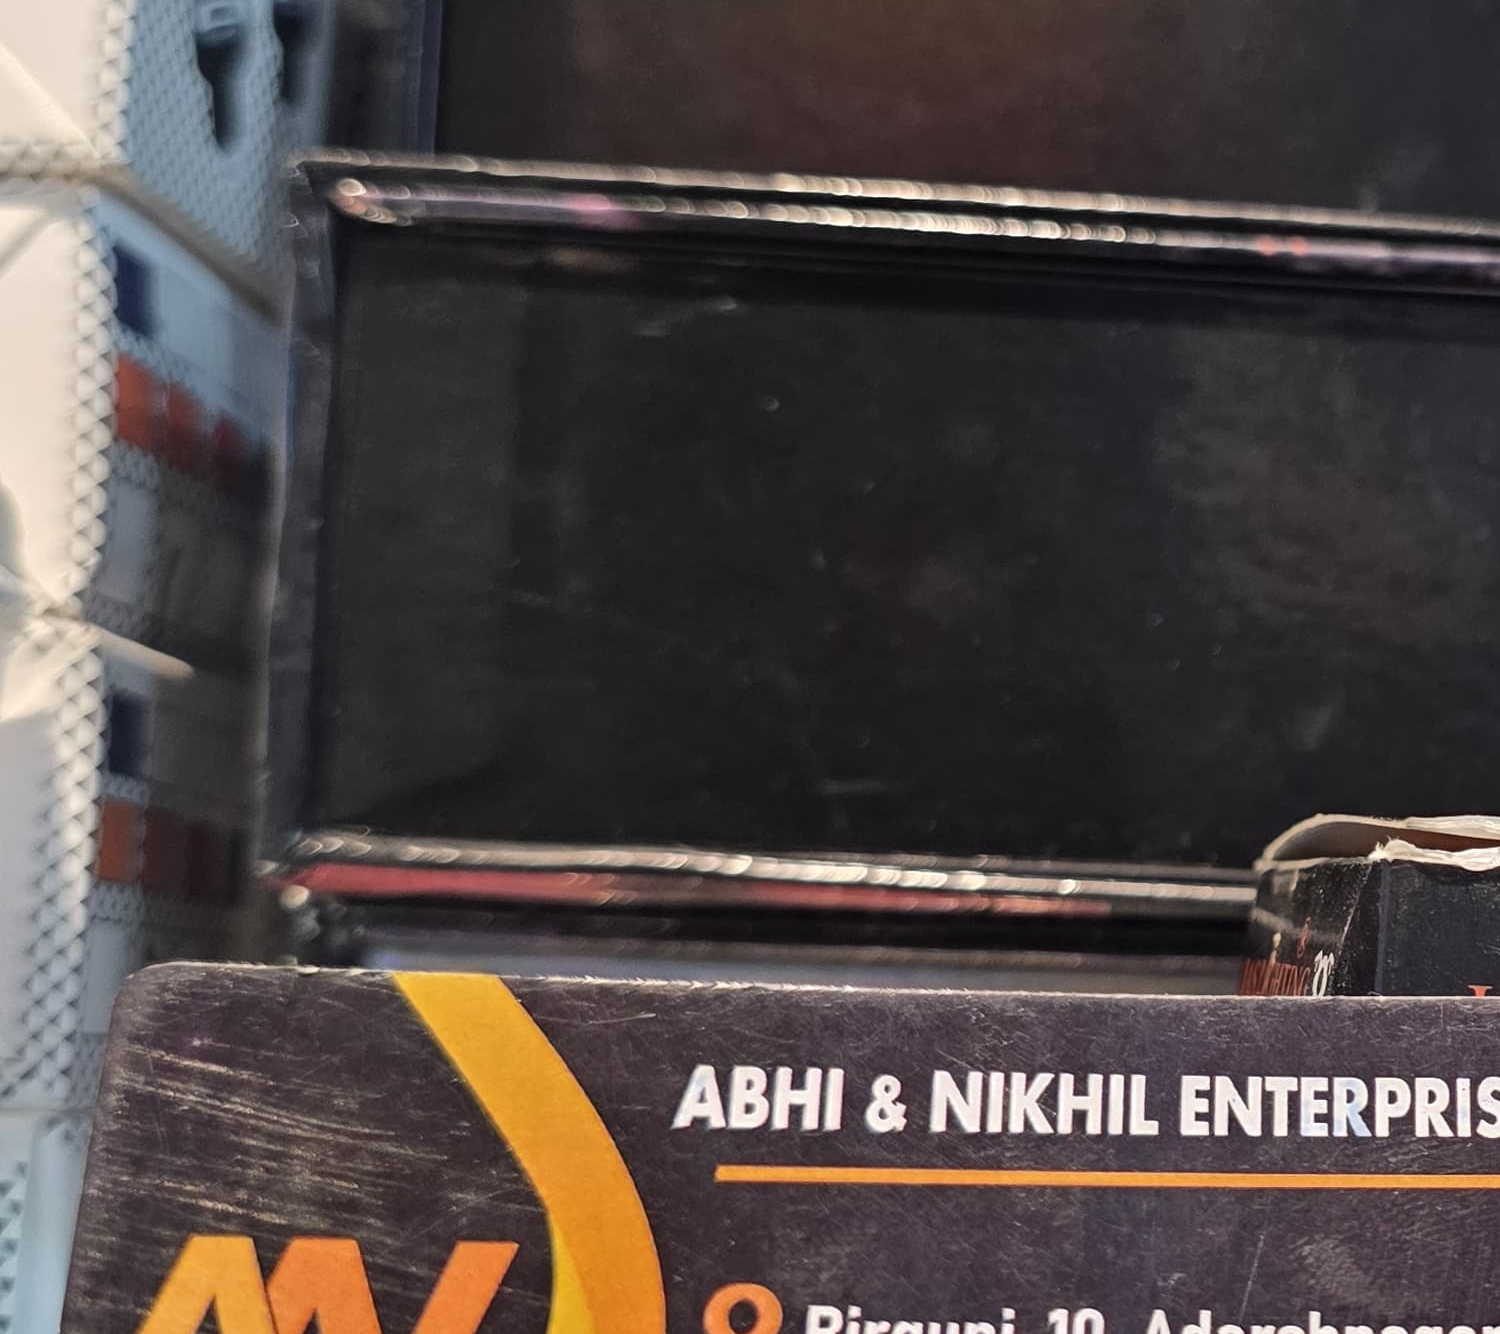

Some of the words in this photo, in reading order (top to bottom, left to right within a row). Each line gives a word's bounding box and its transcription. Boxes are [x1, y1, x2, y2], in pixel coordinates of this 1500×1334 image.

[670, 1064, 845, 1132] ABHI
[864, 1074, 909, 1134] &
[929, 1070, 1159, 1137] NIKHIL
